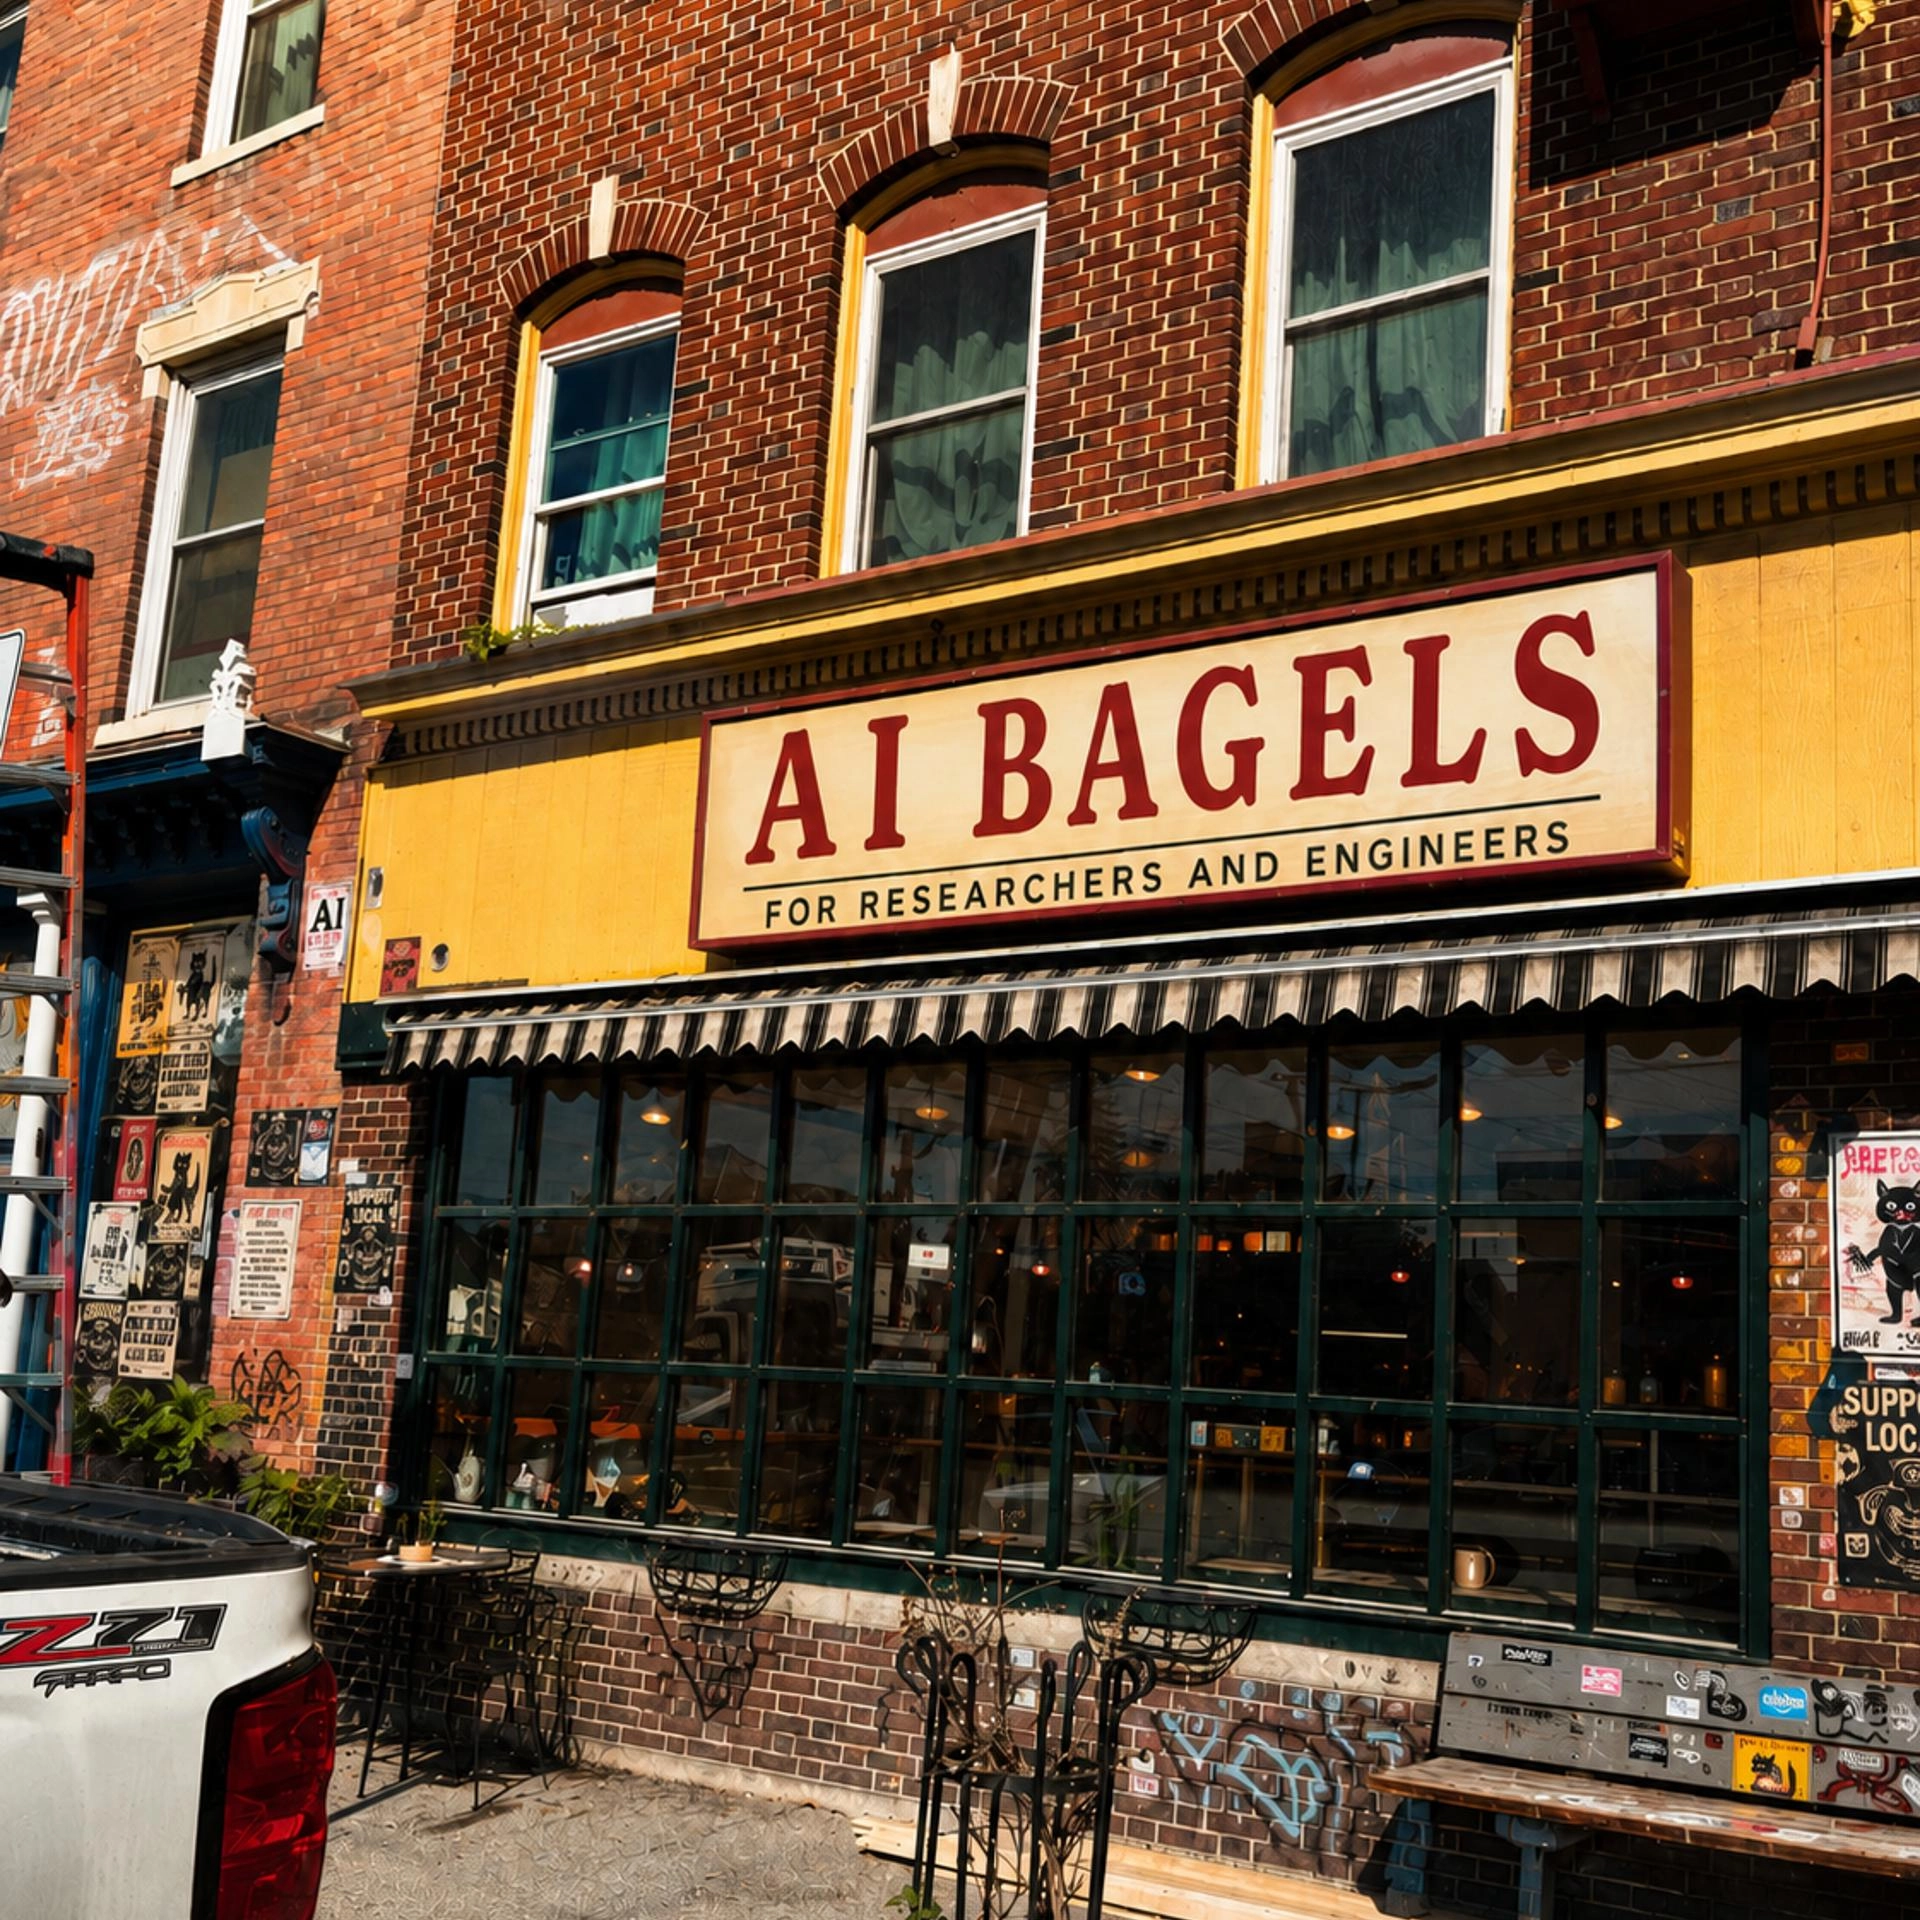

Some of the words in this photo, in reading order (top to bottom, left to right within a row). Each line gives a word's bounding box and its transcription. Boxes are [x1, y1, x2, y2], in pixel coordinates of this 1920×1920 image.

[744, 714, 909, 865] AI
[972, 609, 1600, 838] BAGELS
[765, 895, 836, 929] FOR
[860, 862, 1162, 920] RESEARCHERS
[1188, 851, 1279, 889] AND
[1306, 821, 1569, 877] ENGINEERS
[309, 897, 345, 933] AI
[1843, 1386, 1920, 1418] SUPP
[1866, 1421, 1920, 1454] LOC
